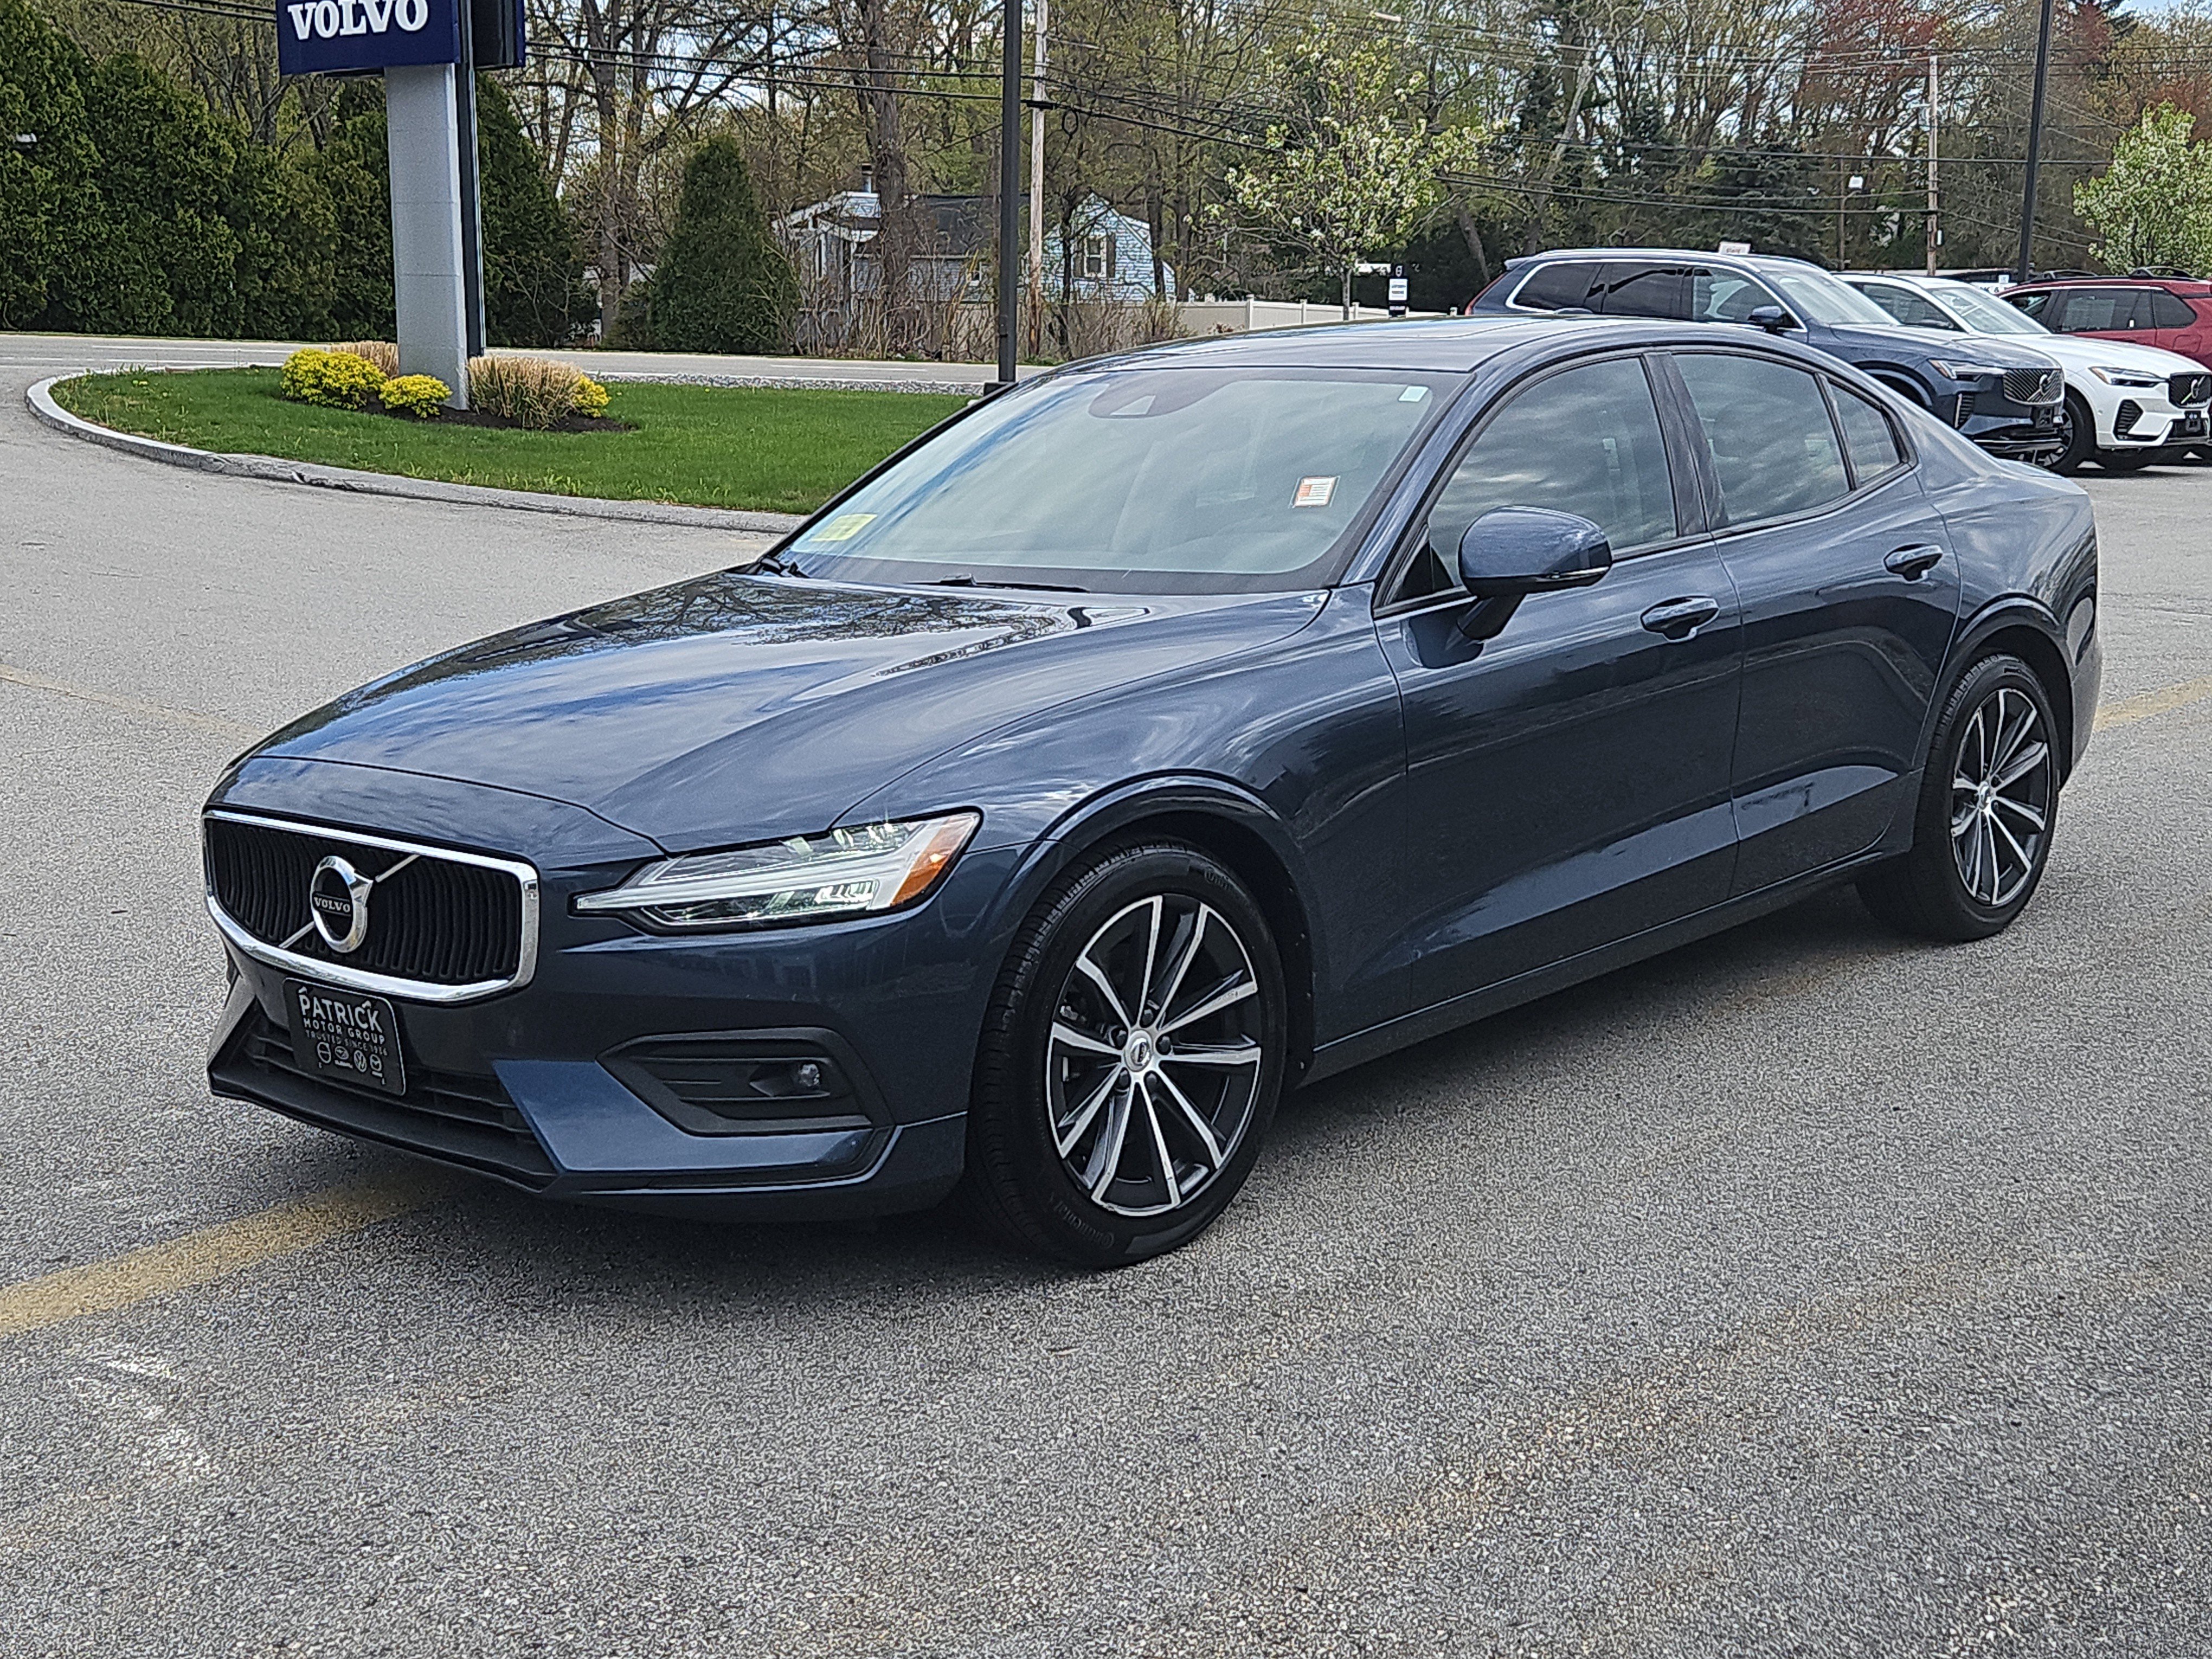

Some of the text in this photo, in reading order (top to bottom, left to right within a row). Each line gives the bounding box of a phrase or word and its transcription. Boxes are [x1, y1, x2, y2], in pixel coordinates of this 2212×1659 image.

[287, 0, 428, 41] VOLVO
[313, 897, 351, 913] VOLVO
[298, 994, 383, 1033] PATRICK
[304, 1018, 385, 1045] MOTOR GROUP
